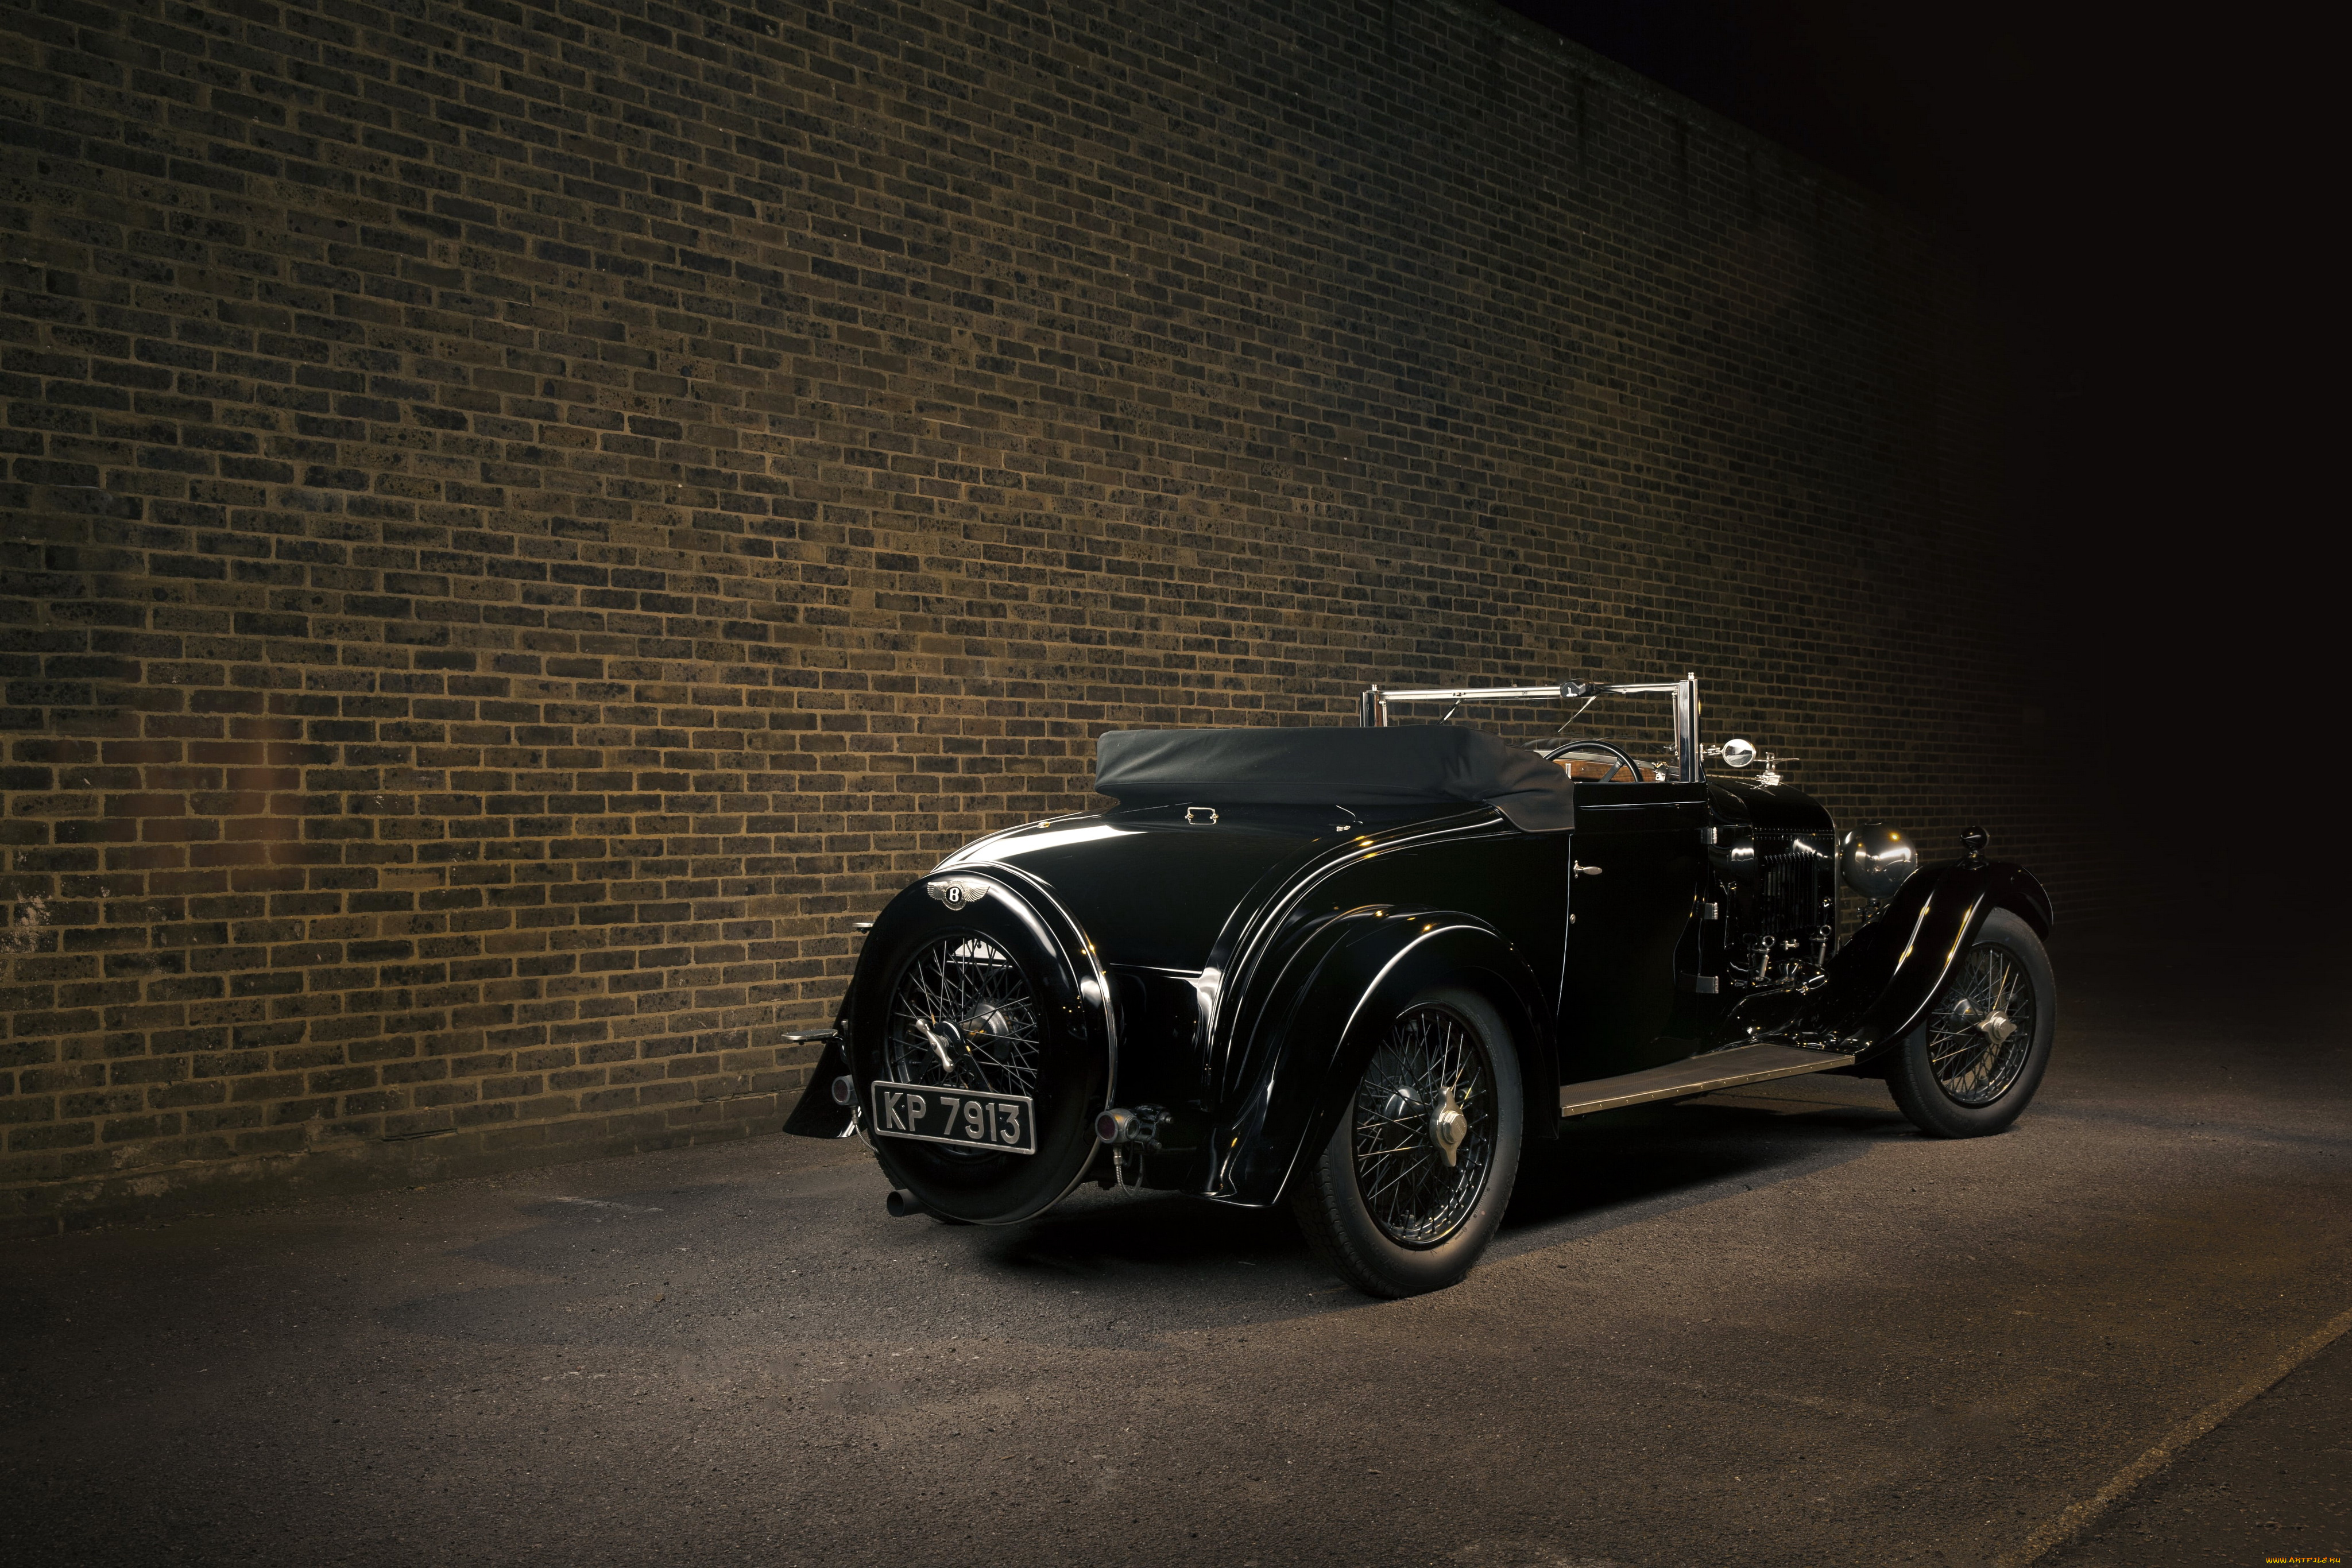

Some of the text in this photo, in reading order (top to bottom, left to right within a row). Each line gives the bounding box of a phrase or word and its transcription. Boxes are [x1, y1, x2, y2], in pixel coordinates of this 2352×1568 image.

[949, 887, 960, 902] B
[884, 1091, 1020, 1144] KP 7913
